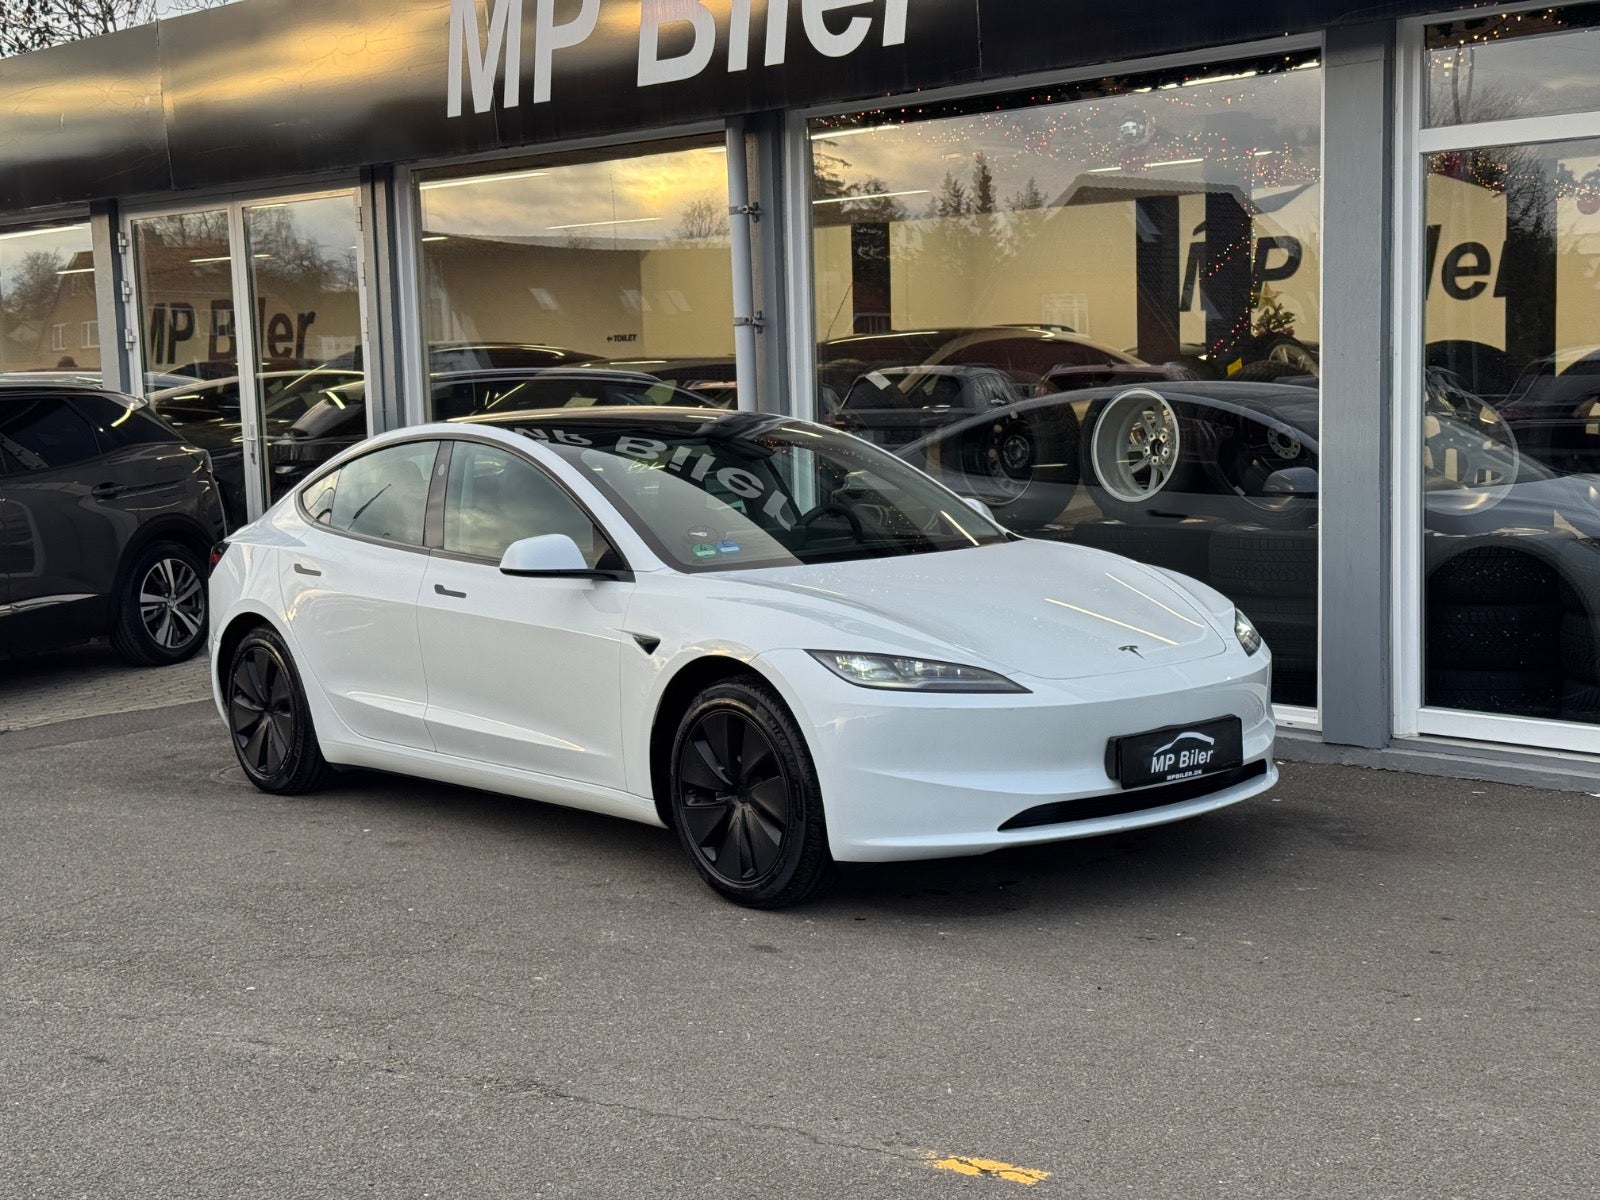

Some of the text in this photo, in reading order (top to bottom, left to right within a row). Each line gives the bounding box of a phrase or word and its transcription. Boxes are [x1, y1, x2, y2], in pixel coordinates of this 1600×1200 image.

[447, 0, 600, 118] MP
[613, 334, 637, 342] TOILET
[1151, 748, 1214, 774] MP Biler
